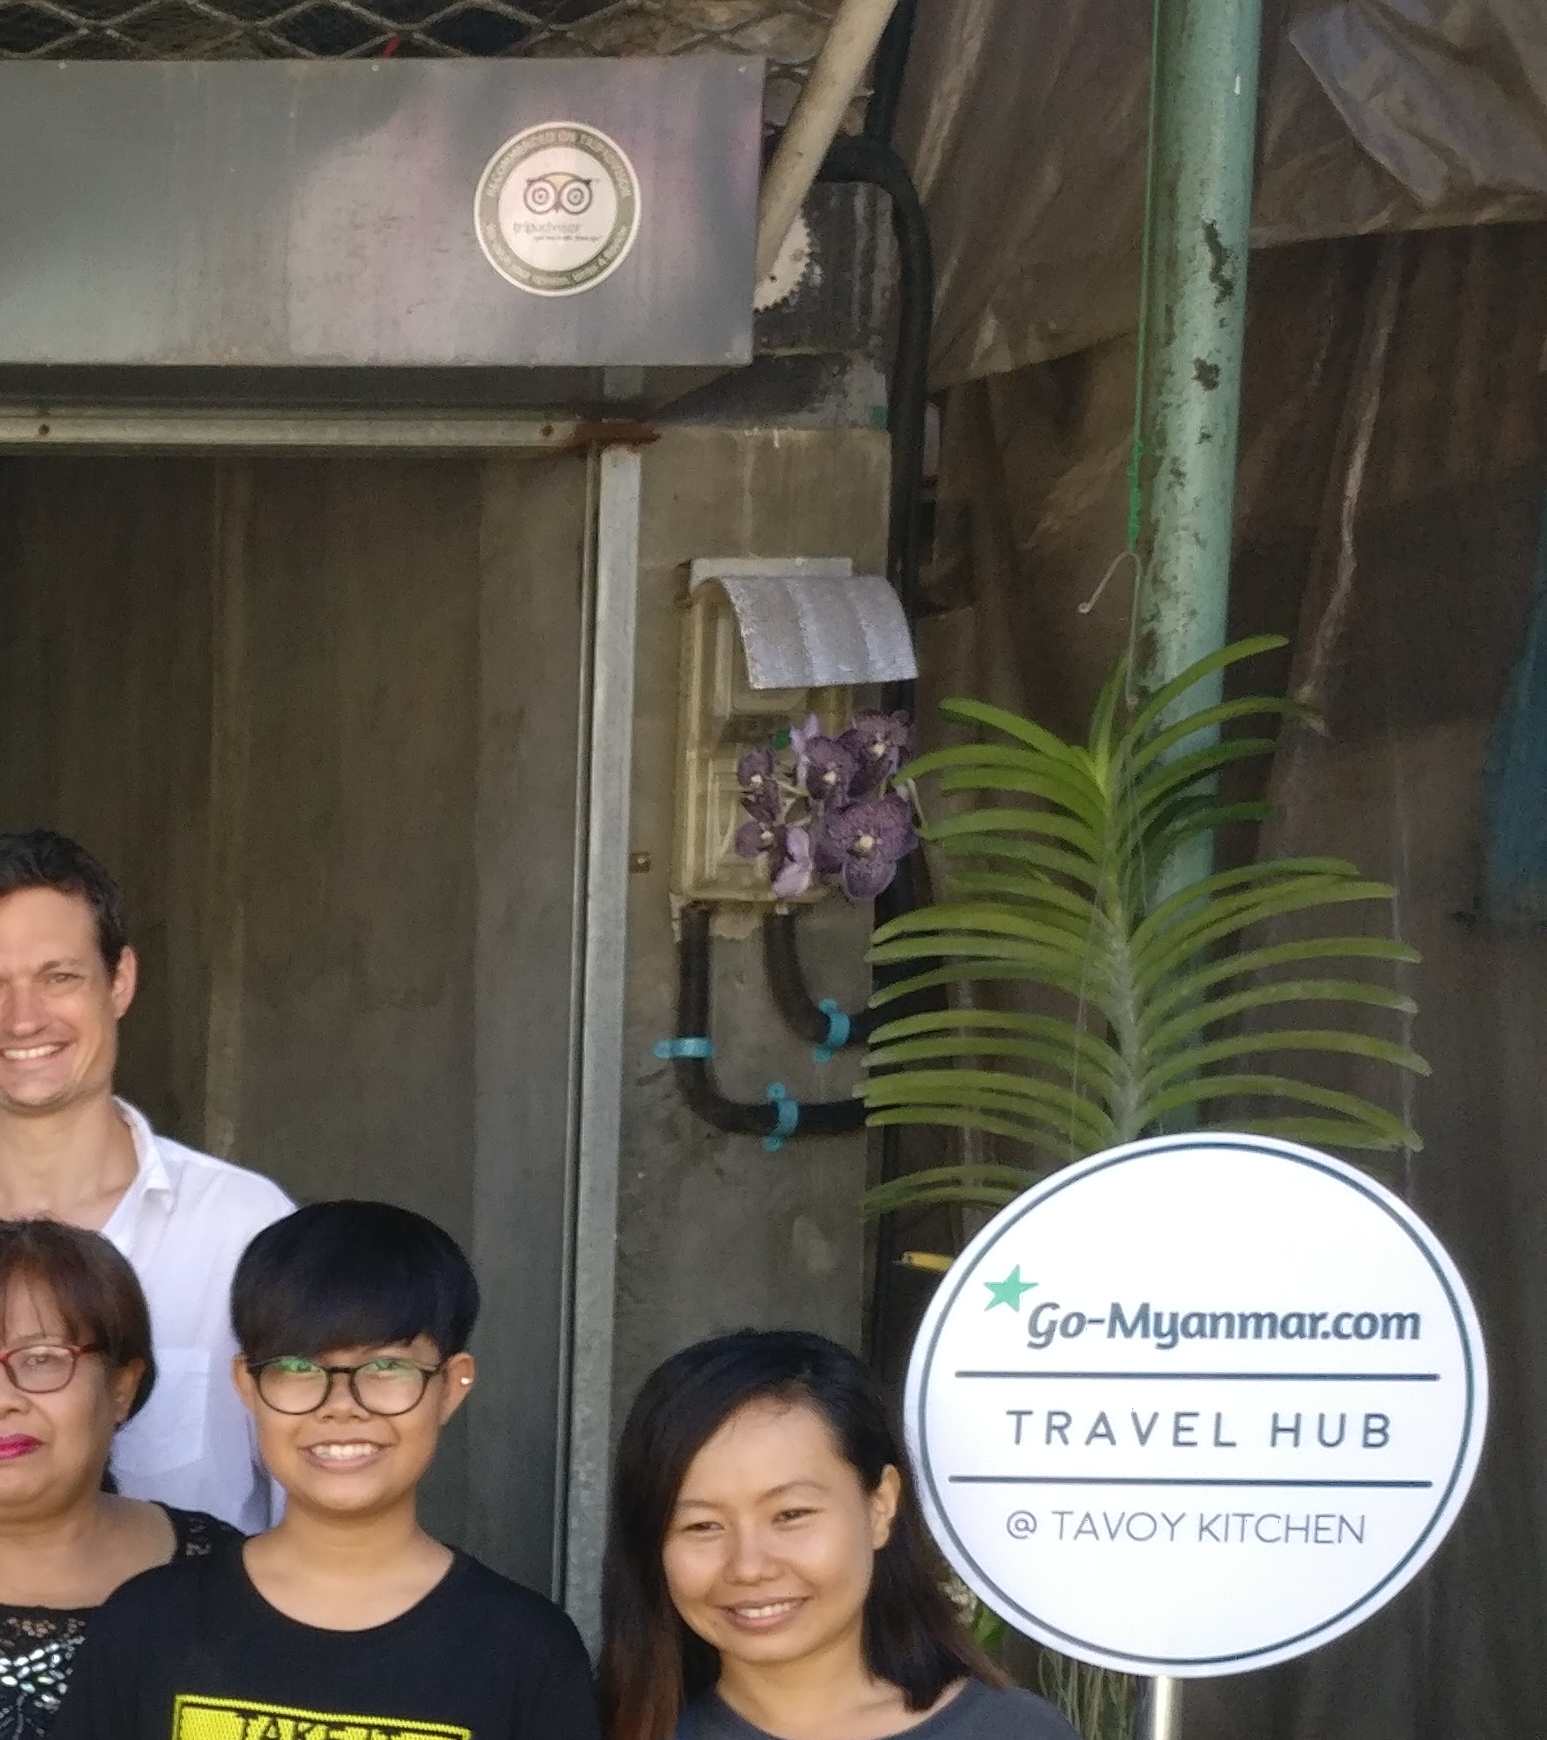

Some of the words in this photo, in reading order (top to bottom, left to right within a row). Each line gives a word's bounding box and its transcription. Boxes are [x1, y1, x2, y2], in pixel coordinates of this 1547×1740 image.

[1026, 1300, 1422, 1349] Go-Myanmar.com
[1006, 1410, 1237, 1448] TRAVEL
[1270, 1412, 1393, 1449] HUB
[1006, 1509, 1039, 1540] @
[1051, 1510, 1187, 1542] TAVOY
[1198, 1512, 1366, 1544] KITCHEN
